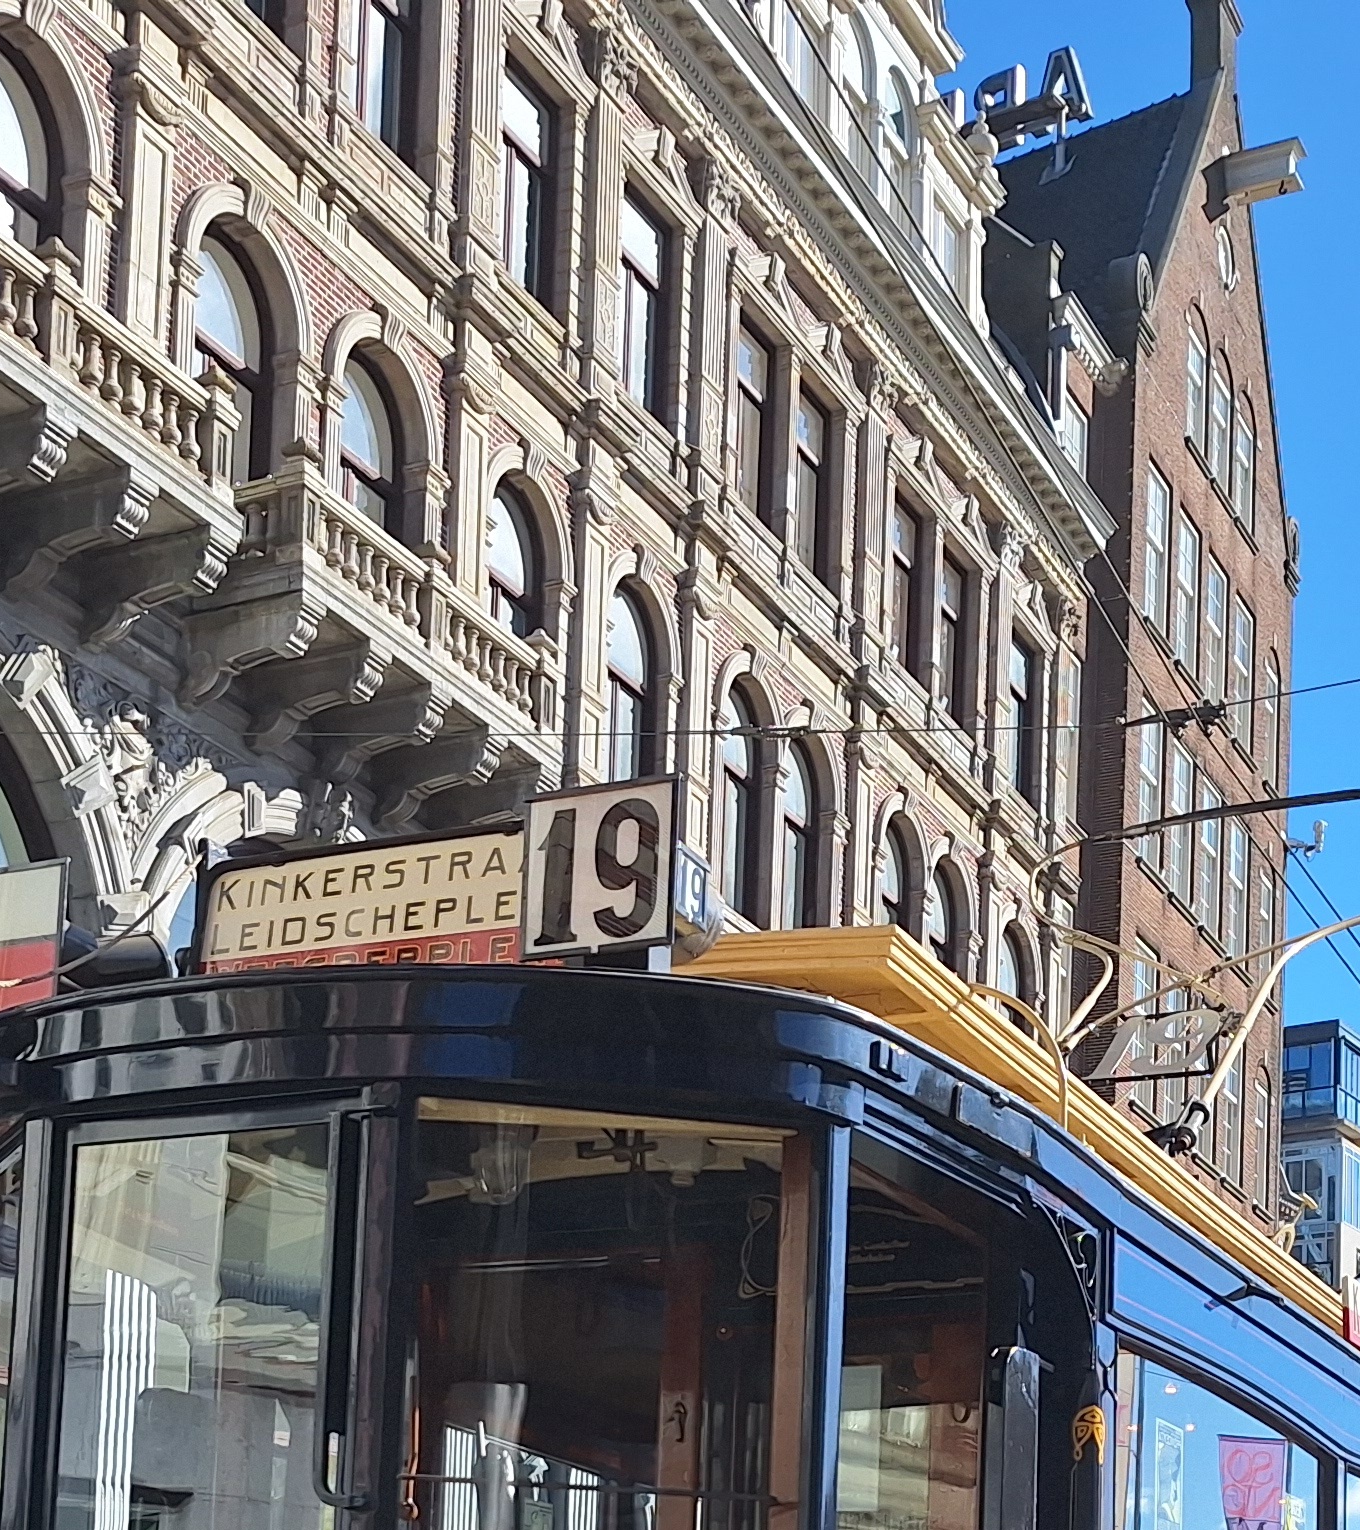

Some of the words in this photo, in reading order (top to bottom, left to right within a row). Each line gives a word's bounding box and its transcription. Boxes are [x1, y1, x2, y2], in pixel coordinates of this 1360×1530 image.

[216, 846, 526, 913] KINKERSTRA
[533, 797, 660, 947] 19
[210, 890, 518, 956] LEIDSCHEPLE
